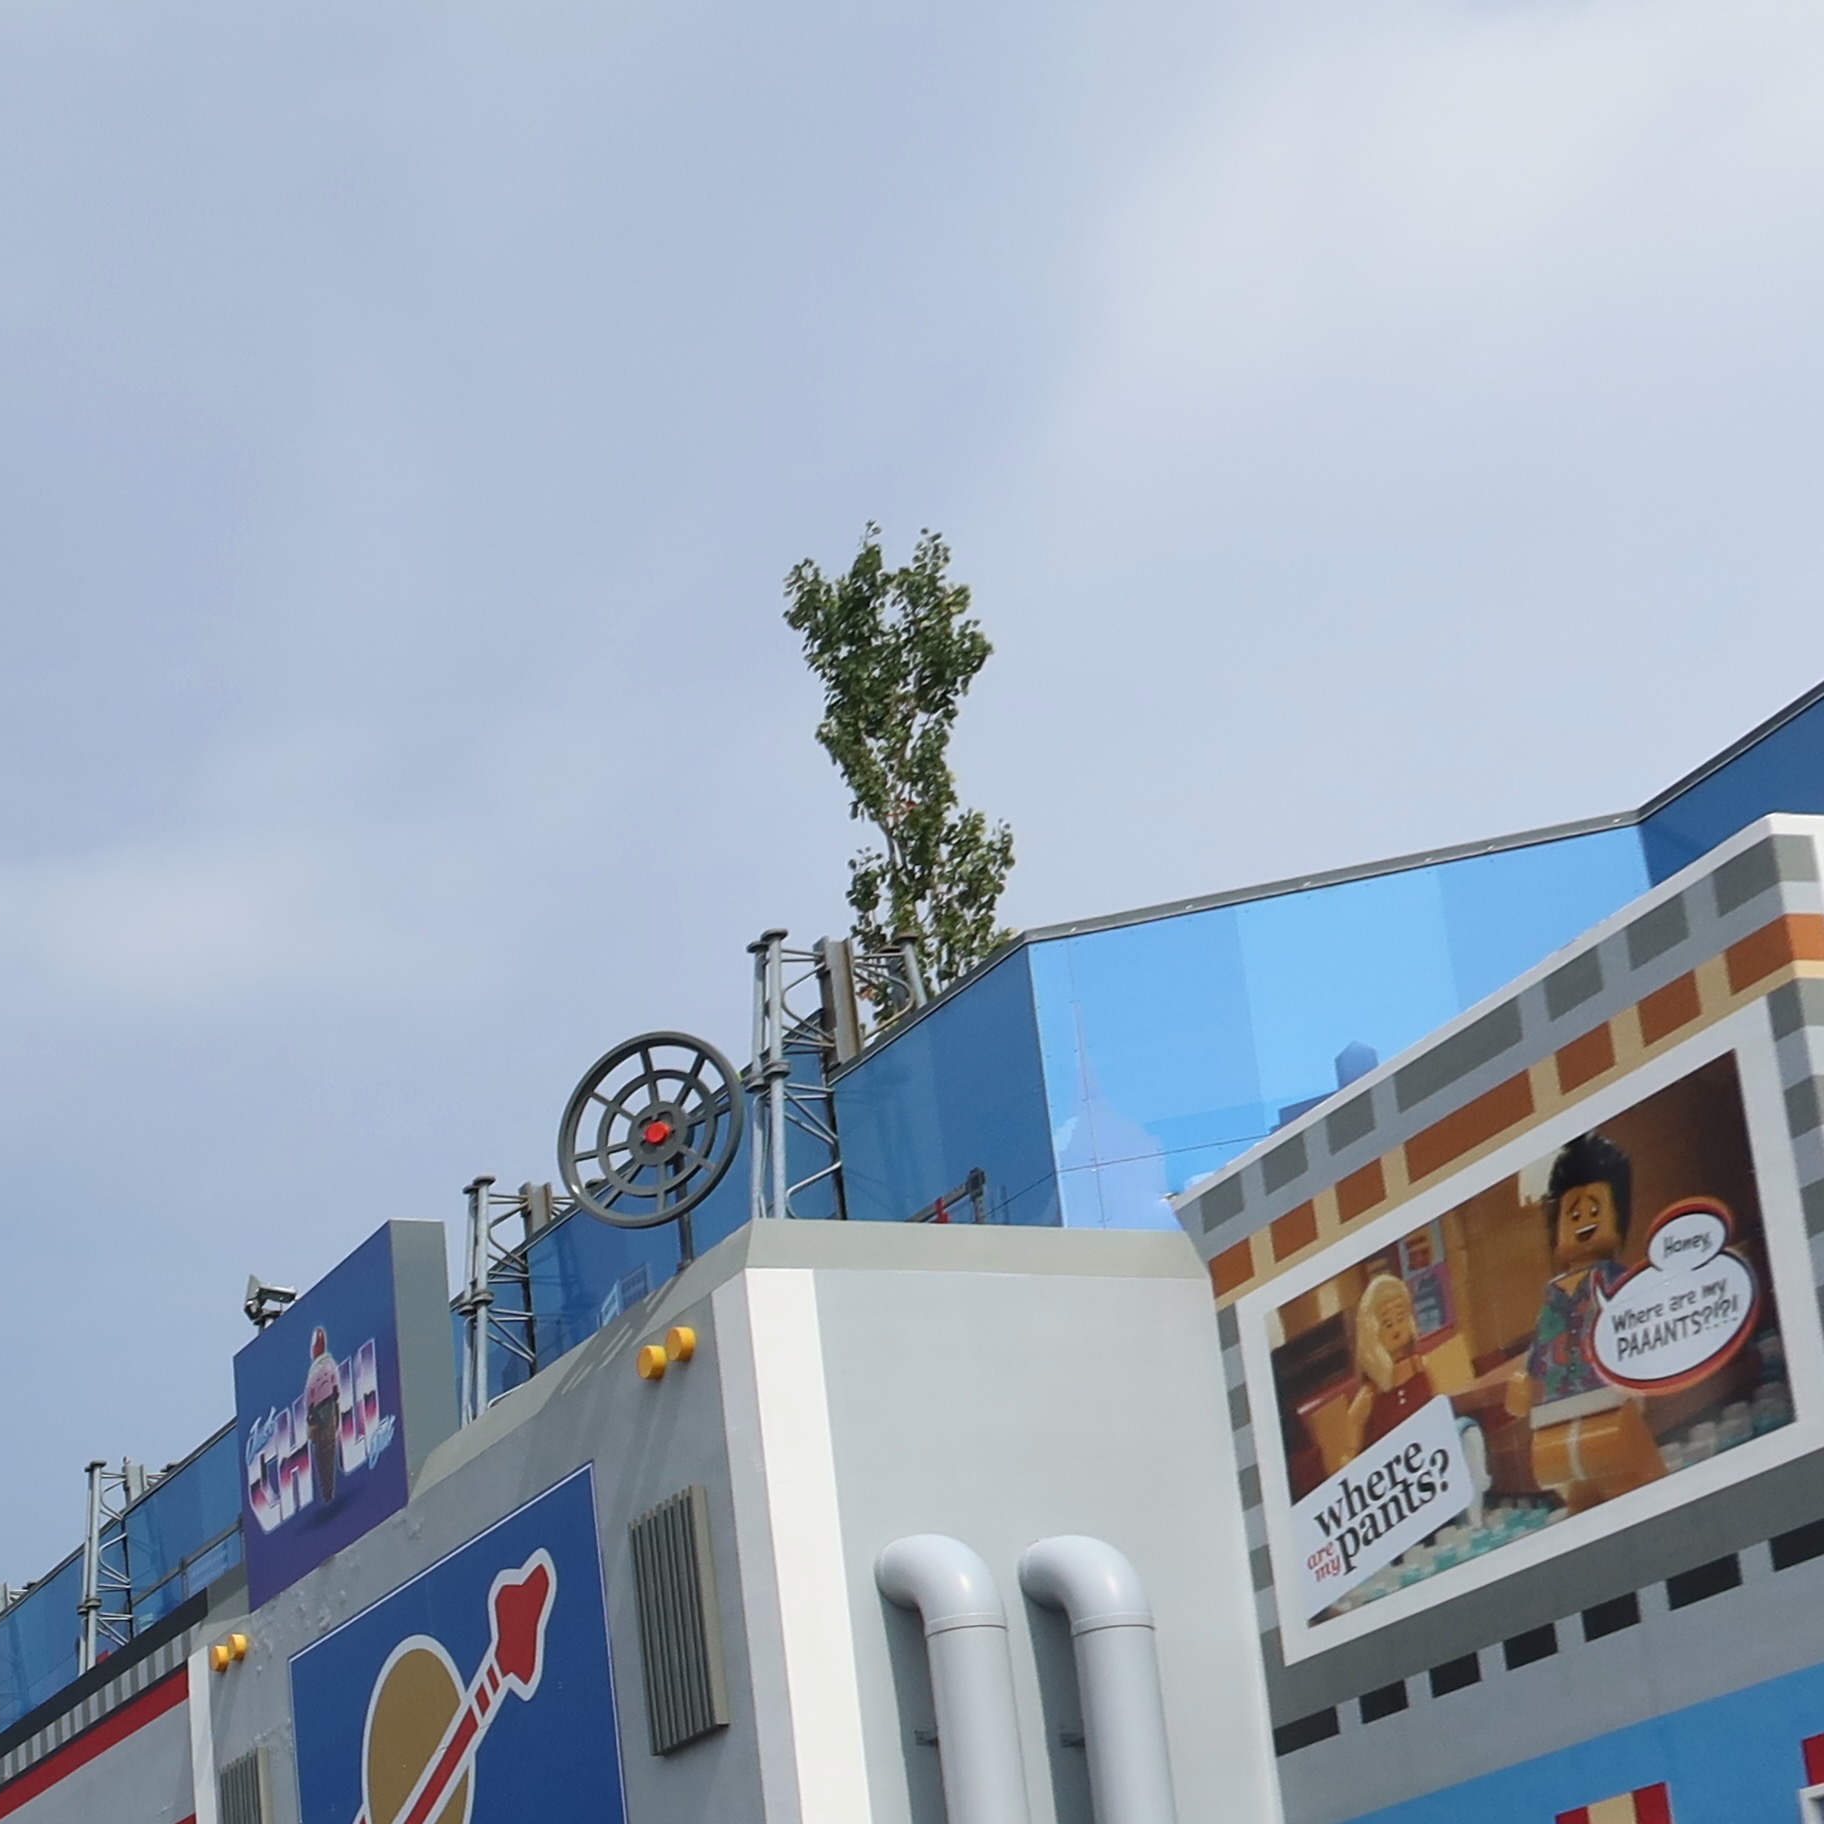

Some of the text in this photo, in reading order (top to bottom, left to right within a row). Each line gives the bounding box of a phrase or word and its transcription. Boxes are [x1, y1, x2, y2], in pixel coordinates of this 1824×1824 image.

[1611, 1278, 1727, 1334] Where are my
[1313, 1442, 1424, 1538] where
[1334, 1447, 1450, 1576] pants?
[1307, 1542, 1334, 1570] are
[1315, 1555, 1342, 1582] my
